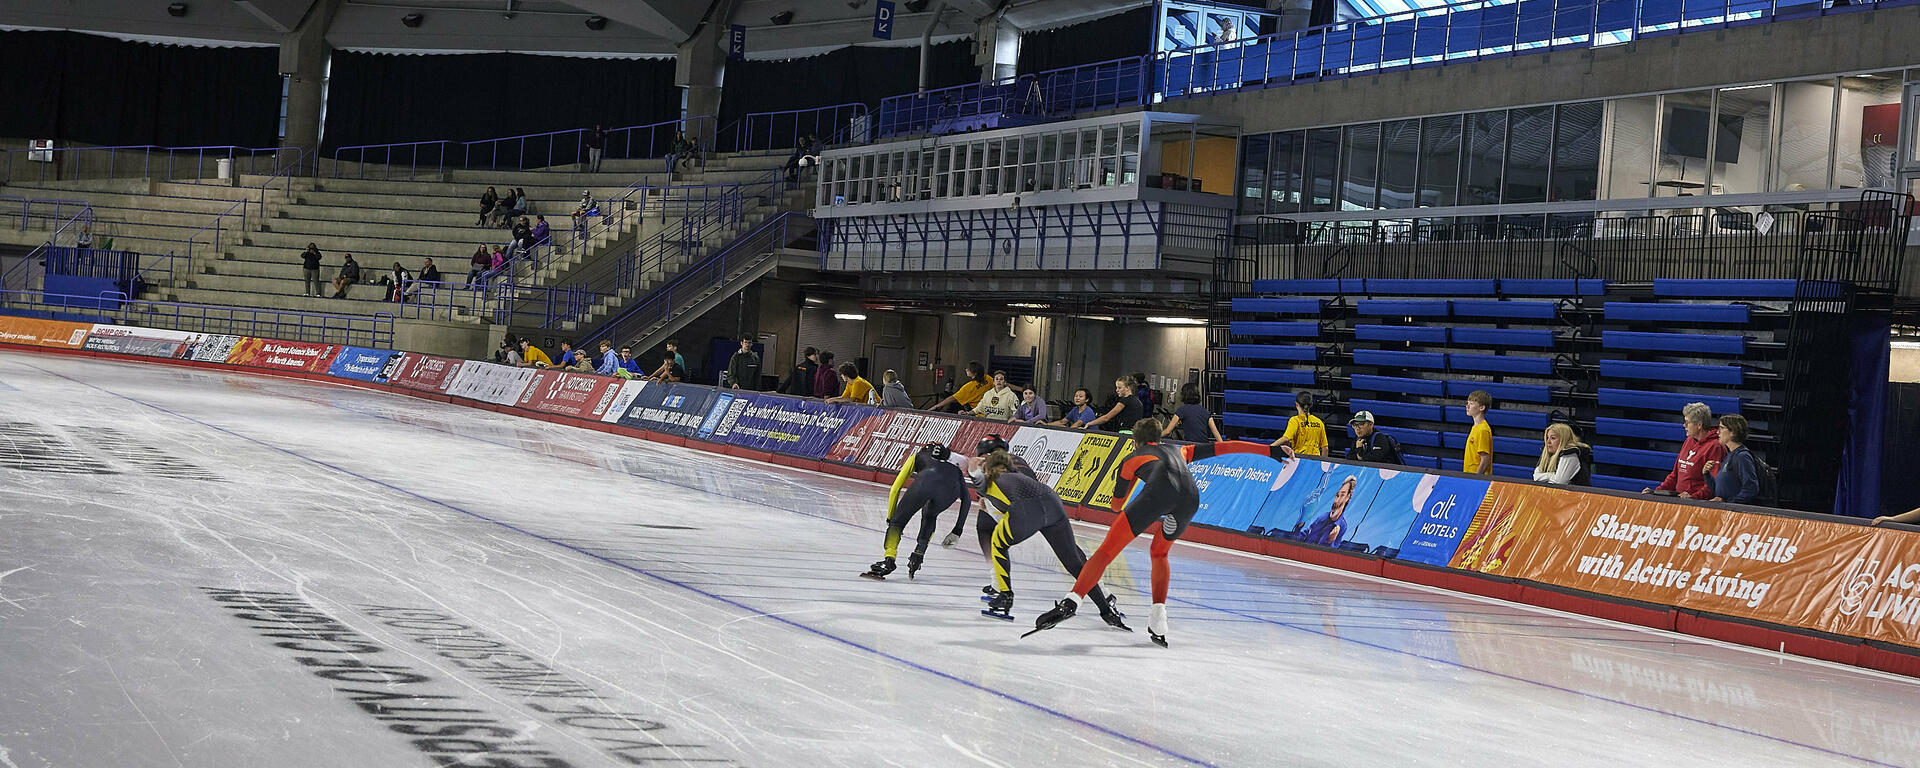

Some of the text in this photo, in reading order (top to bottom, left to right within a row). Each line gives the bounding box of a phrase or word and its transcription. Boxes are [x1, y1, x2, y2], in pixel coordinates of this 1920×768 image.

[879, 7, 890, 20] D
[734, 31, 742, 43] E
[272, 356, 287, 365] North
[275, 345, 291, 355] Sport
[743, 402, 846, 433] See what's happening in Calgary
[911, 417, 962, 448] FORWARD
[1084, 436, 1114, 449] STROLLER
[862, 439, 892, 467] PLUS
[1210, 463, 1246, 481] University
[1244, 467, 1273, 483] District
[1056, 486, 1084, 499] CROSSING
[1430, 494, 1457, 520] alt
[1420, 522, 1458, 539] HOTELS
[1591, 513, 1798, 563] Sharpen Your Skills
[1576, 552, 1771, 608] with Active Living
[1881, 561, 1920, 591] AC
[198, 586, 385, 653] CALGARY
